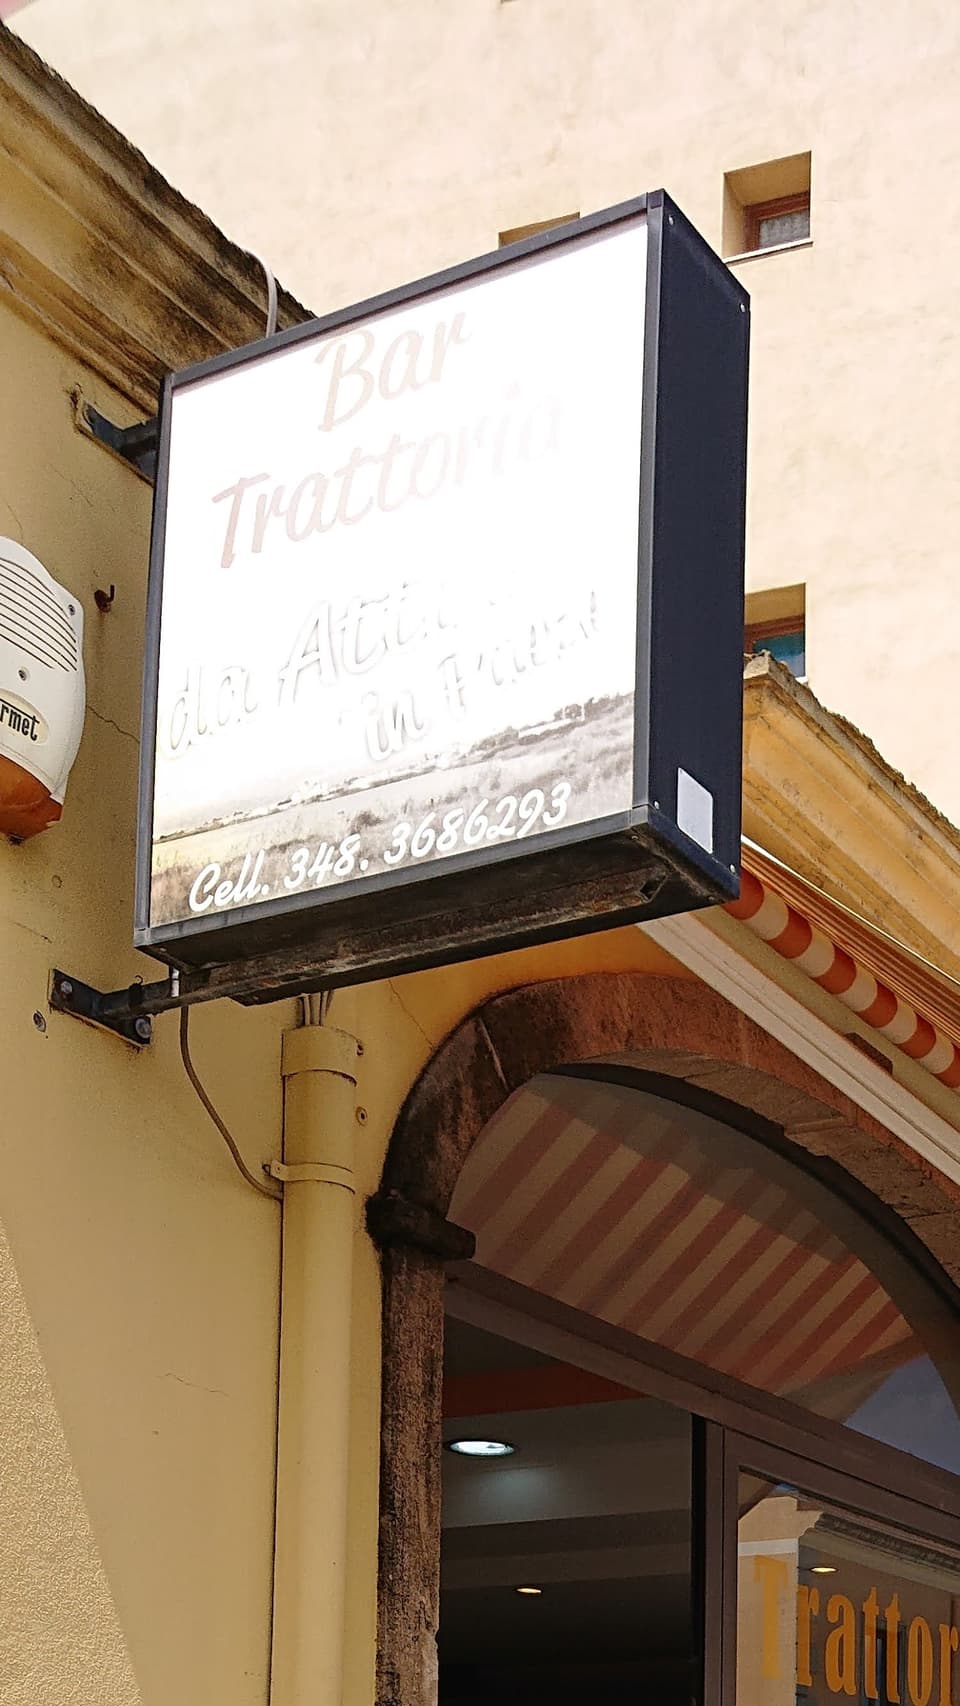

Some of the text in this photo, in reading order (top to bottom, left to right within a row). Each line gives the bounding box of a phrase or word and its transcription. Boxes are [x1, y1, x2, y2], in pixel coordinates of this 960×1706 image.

[312, 311, 473, 434] Bar
[211, 380, 566, 570] Trattoria
[0, 698, 40, 742] rmet
[188, 781, 573, 912] Cell. 348. 3686293
